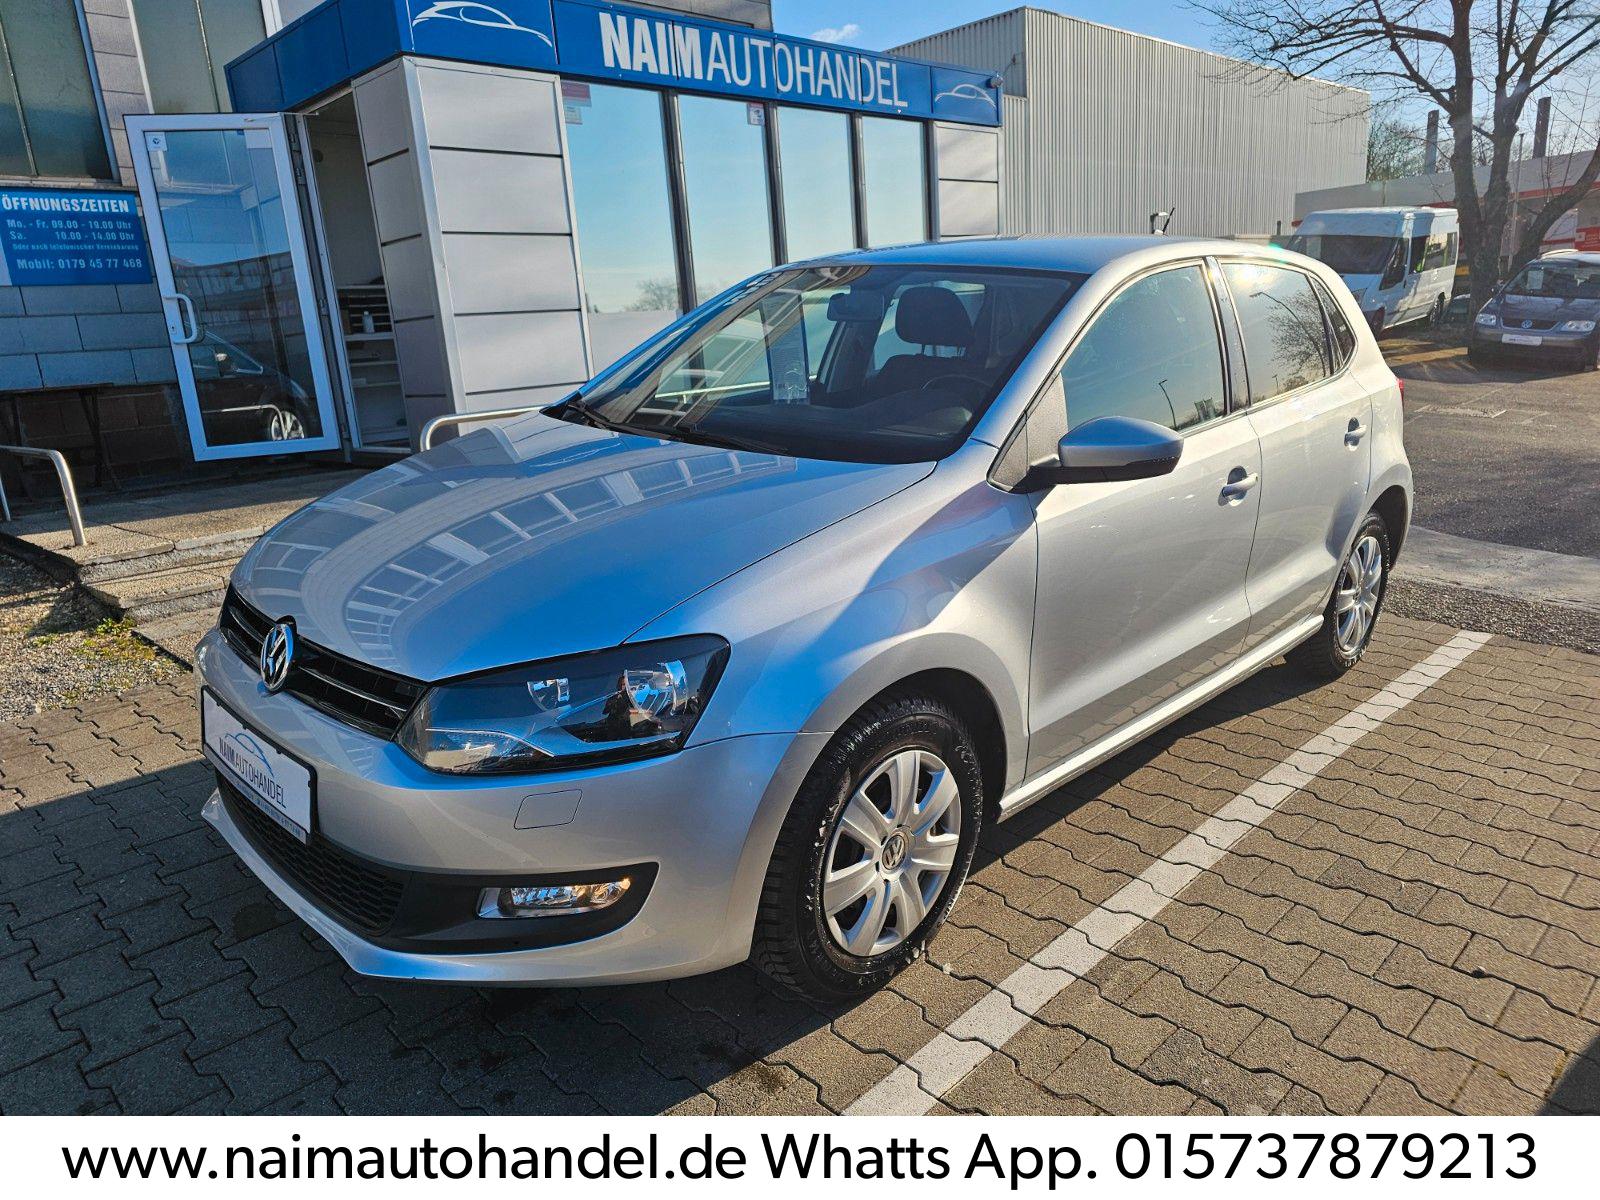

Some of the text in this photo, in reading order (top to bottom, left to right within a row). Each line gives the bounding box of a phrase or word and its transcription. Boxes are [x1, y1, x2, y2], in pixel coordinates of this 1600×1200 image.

[2, 194, 129, 213] ÖFFNUNGSZEITEN
[7, 219, 27, 229] Mo.
[36, 219, 49, 229] Fr.
[116, 220, 132, 229] Uhr
[9, 230, 27, 240] Sa.
[120, 231, 135, 240] Uhr
[17, 259, 142, 269] Mobil: 0179 45 77 468
